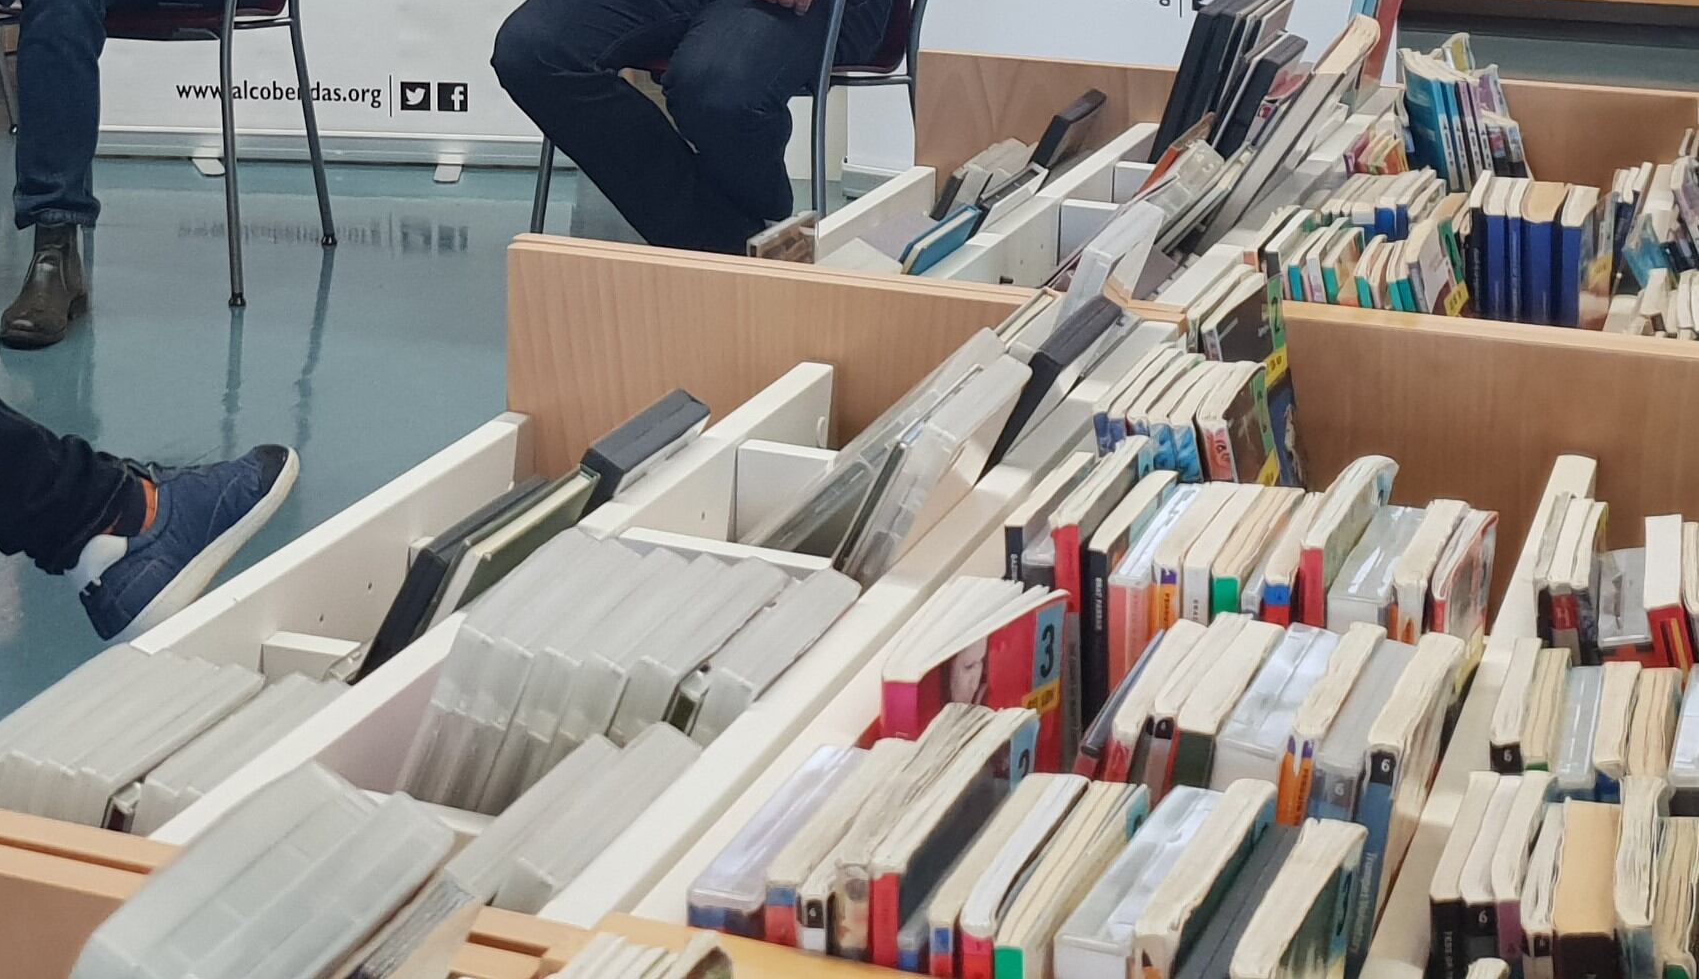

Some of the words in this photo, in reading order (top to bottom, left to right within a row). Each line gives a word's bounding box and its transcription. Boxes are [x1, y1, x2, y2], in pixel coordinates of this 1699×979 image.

[176, 80, 382, 109] wwwalcobedas.org
[1040, 623, 1055, 678] 3
[1380, 758, 1391, 772] 6
[1334, 783, 1345, 797] 6
[1478, 909, 1488, 923] 6
